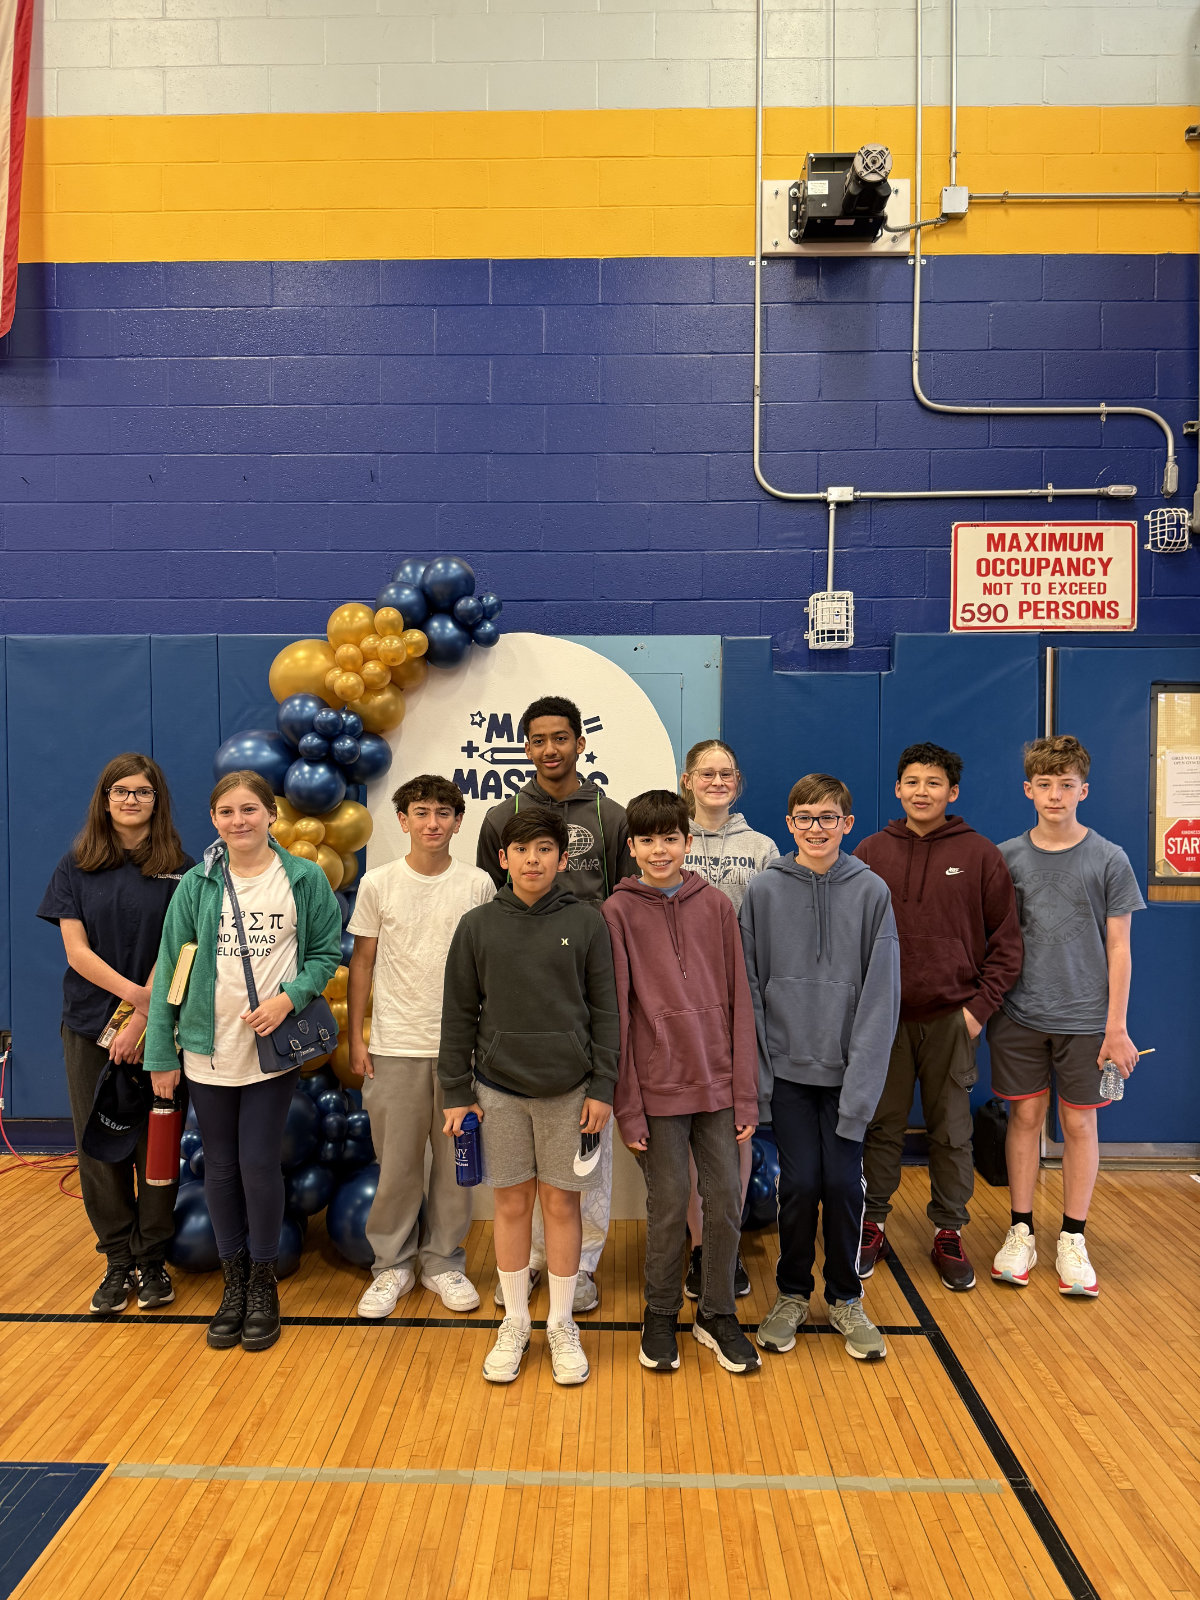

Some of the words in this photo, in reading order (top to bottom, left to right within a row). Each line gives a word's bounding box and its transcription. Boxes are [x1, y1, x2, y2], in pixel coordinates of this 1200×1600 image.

[986, 532, 1104, 552] MAXIMUM
[976, 557, 1113, 577] OCCUPANCY
[982, 582, 1013, 595] NOT
[1021, 582, 1041, 595] TO
[1049, 582, 1106, 595] EXCEED
[960, 603, 1009, 623] 590
[1018, 600, 1119, 620] PERSONS
[1167, 837, 1200, 855] STAR
[217, 933, 231, 943] ND
[249, 934, 276, 944] WAS
